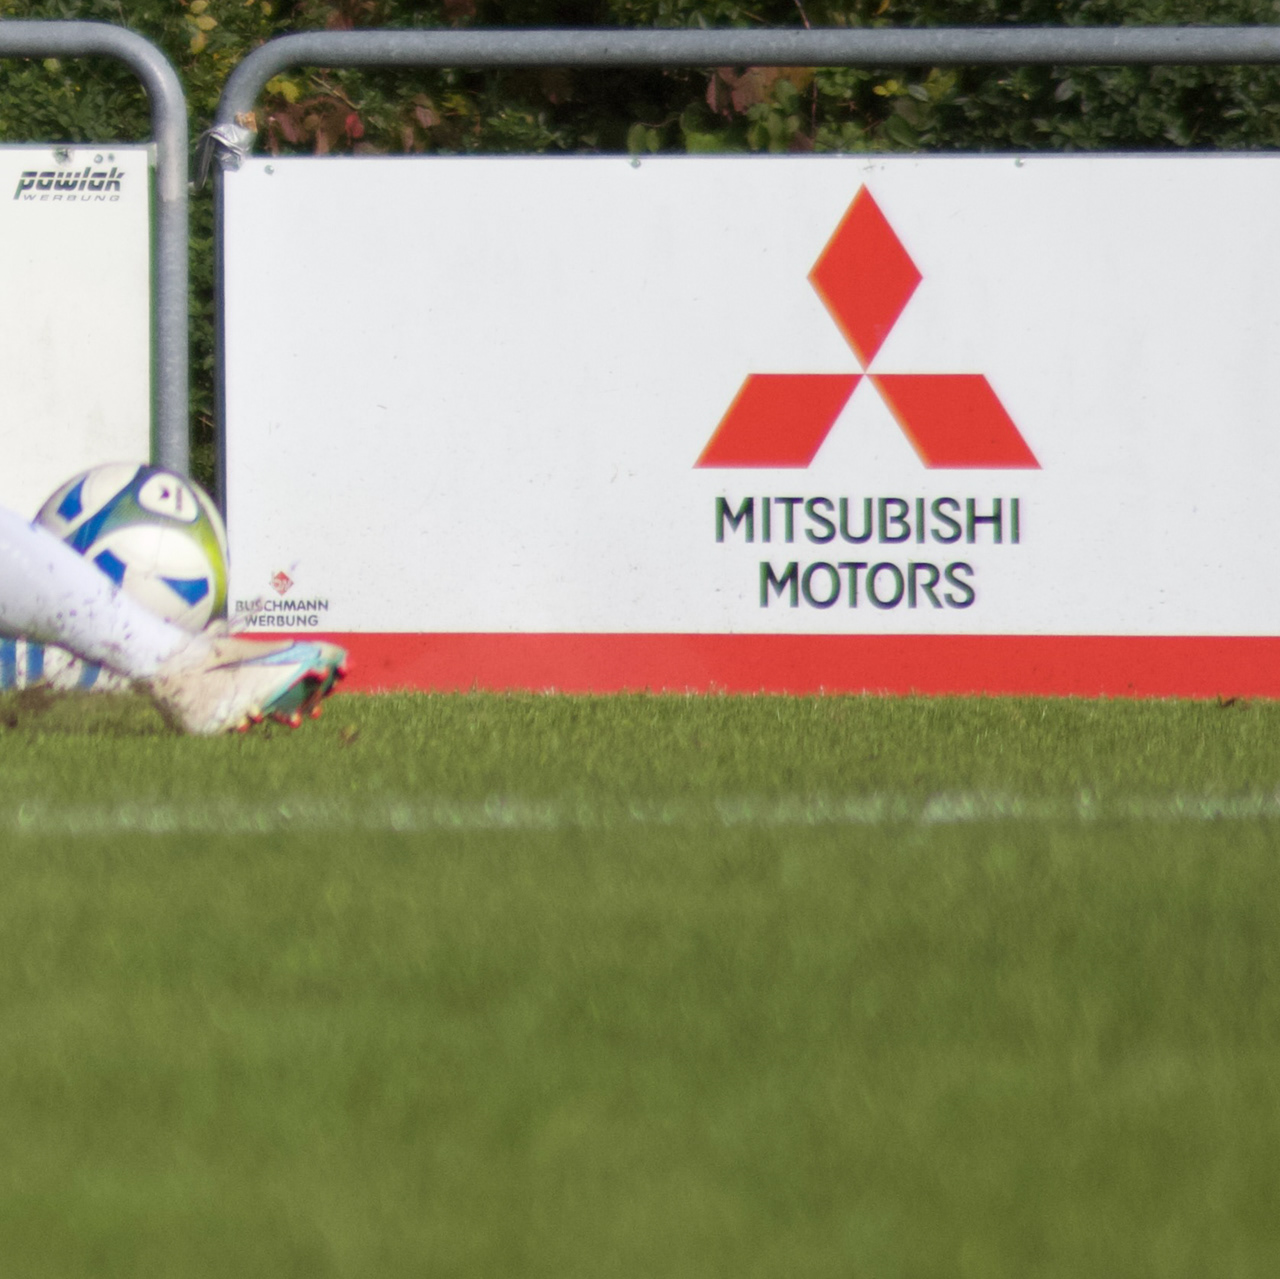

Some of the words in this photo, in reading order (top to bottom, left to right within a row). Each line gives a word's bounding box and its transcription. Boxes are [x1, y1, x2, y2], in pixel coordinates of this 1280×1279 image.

[13, 166, 125, 200] pawlak
[23, 194, 121, 202] WERBUNG
[715, 496, 1021, 545] MITSUBISHI
[759, 561, 976, 610] MOTORS
[235, 600, 329, 612] BUSCHMANN
[245, 615, 319, 627] WERBUNG
